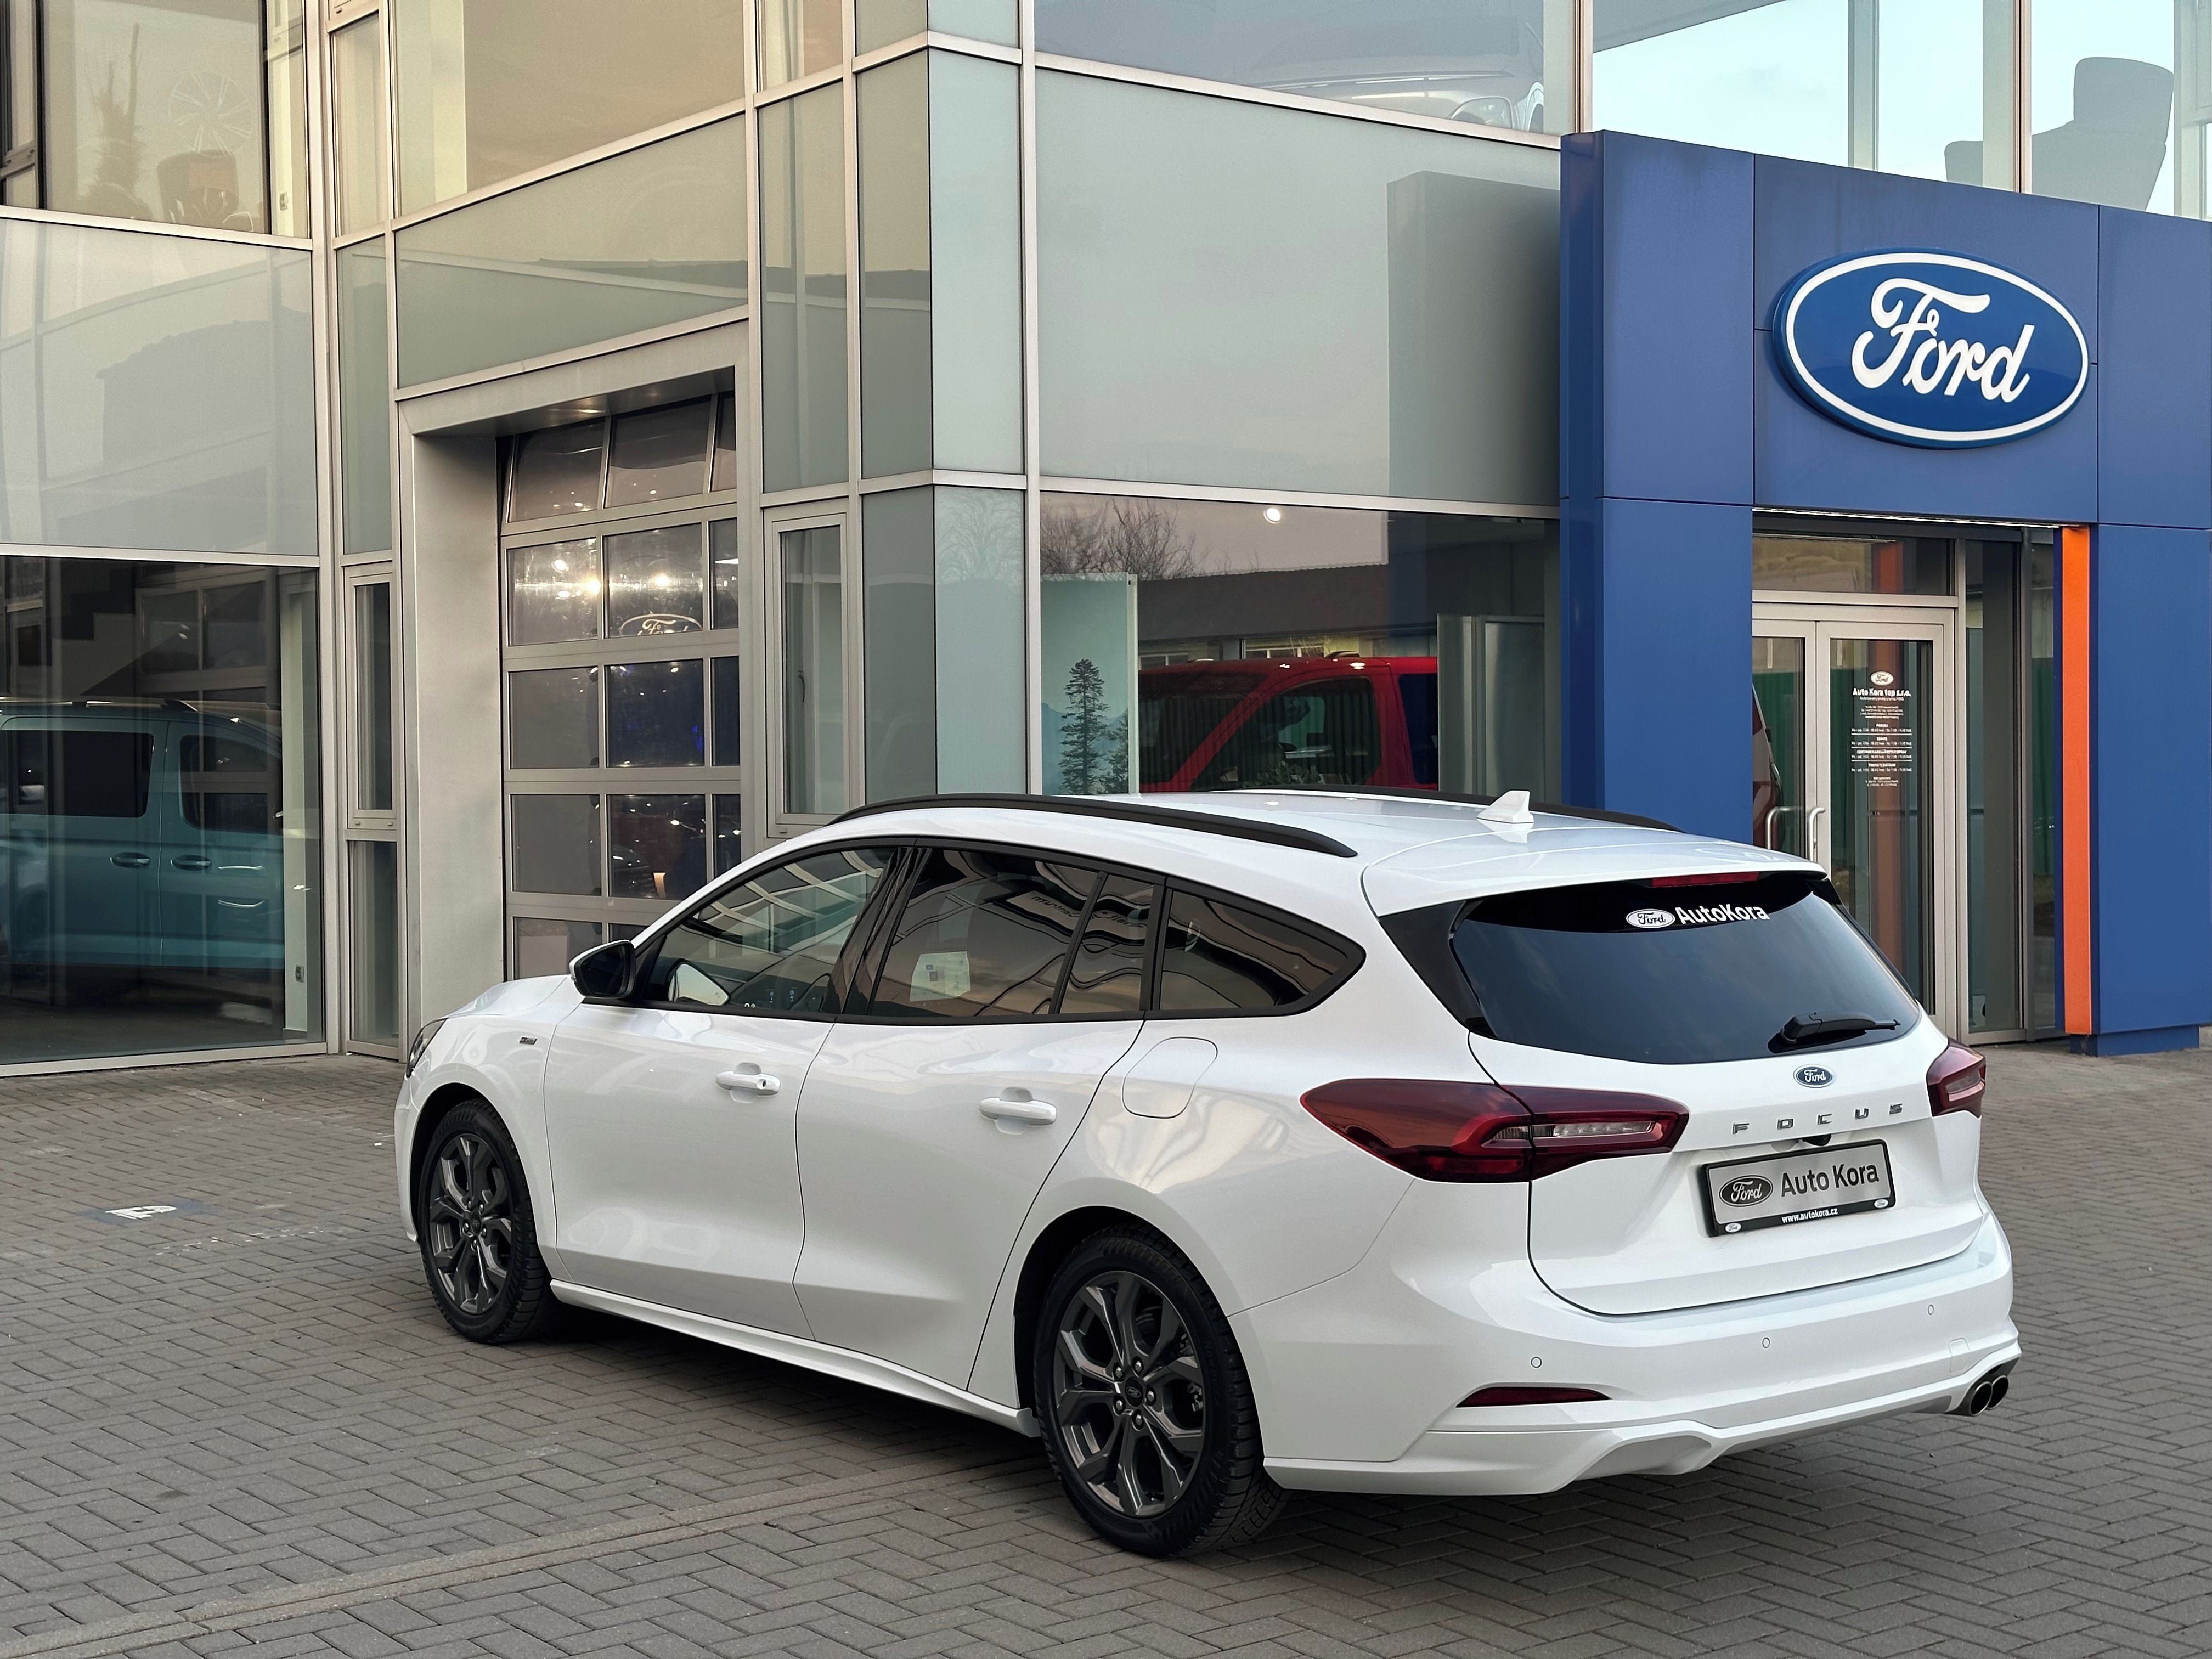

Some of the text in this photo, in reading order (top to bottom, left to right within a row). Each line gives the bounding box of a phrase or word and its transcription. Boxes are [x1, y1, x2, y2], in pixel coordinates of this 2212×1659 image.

[1852, 278, 2035, 403] Ford
[1852, 687, 1869, 696] Auto
[1869, 687, 1884, 696] Kora
[1884, 689, 1896, 697] top
[1637, 904, 1771, 926] Ford AutoKora
[1803, 1069, 1827, 1083] Ford
[1732, 1103, 1903, 1135] FOCUS
[1730, 1163, 1880, 1203] Ford Auto Kora
[1781, 1207, 1838, 1224] www.autokora.cz
